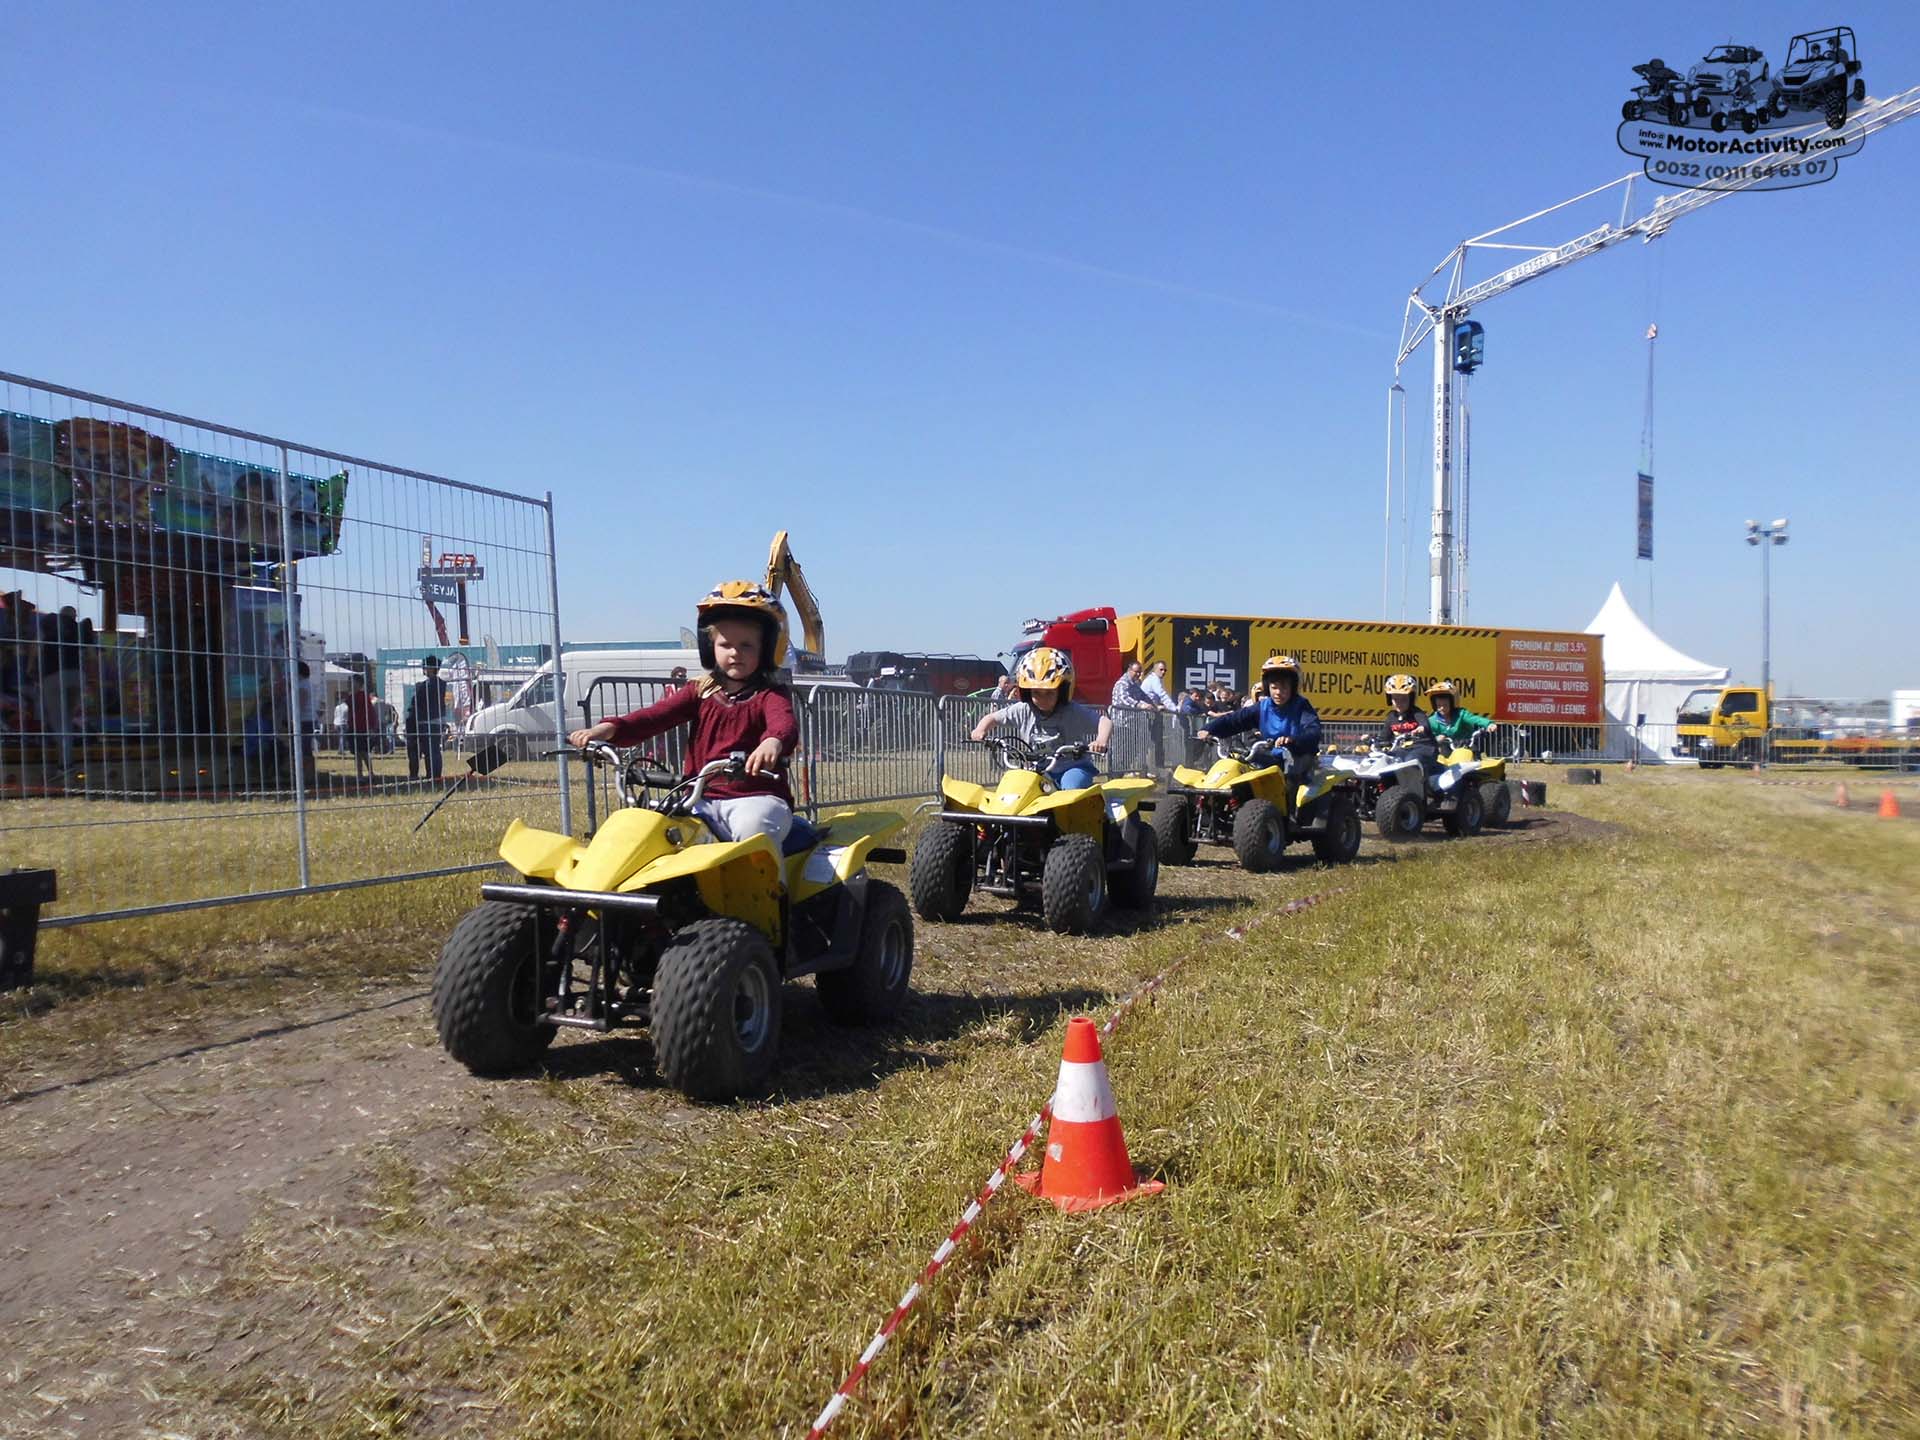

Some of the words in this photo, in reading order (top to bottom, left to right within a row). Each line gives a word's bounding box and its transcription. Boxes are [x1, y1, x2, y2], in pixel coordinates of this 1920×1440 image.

[1310, 649, 1367, 665] EQUIPMENT
[1370, 652, 1419, 668] AUCTIONS
[1555, 661, 1585, 673] AUCTION
[1562, 680, 1590, 692] BUYERS
[1507, 702, 1517, 713] A2
[1517, 703, 1556, 714] EINDHOVEN
